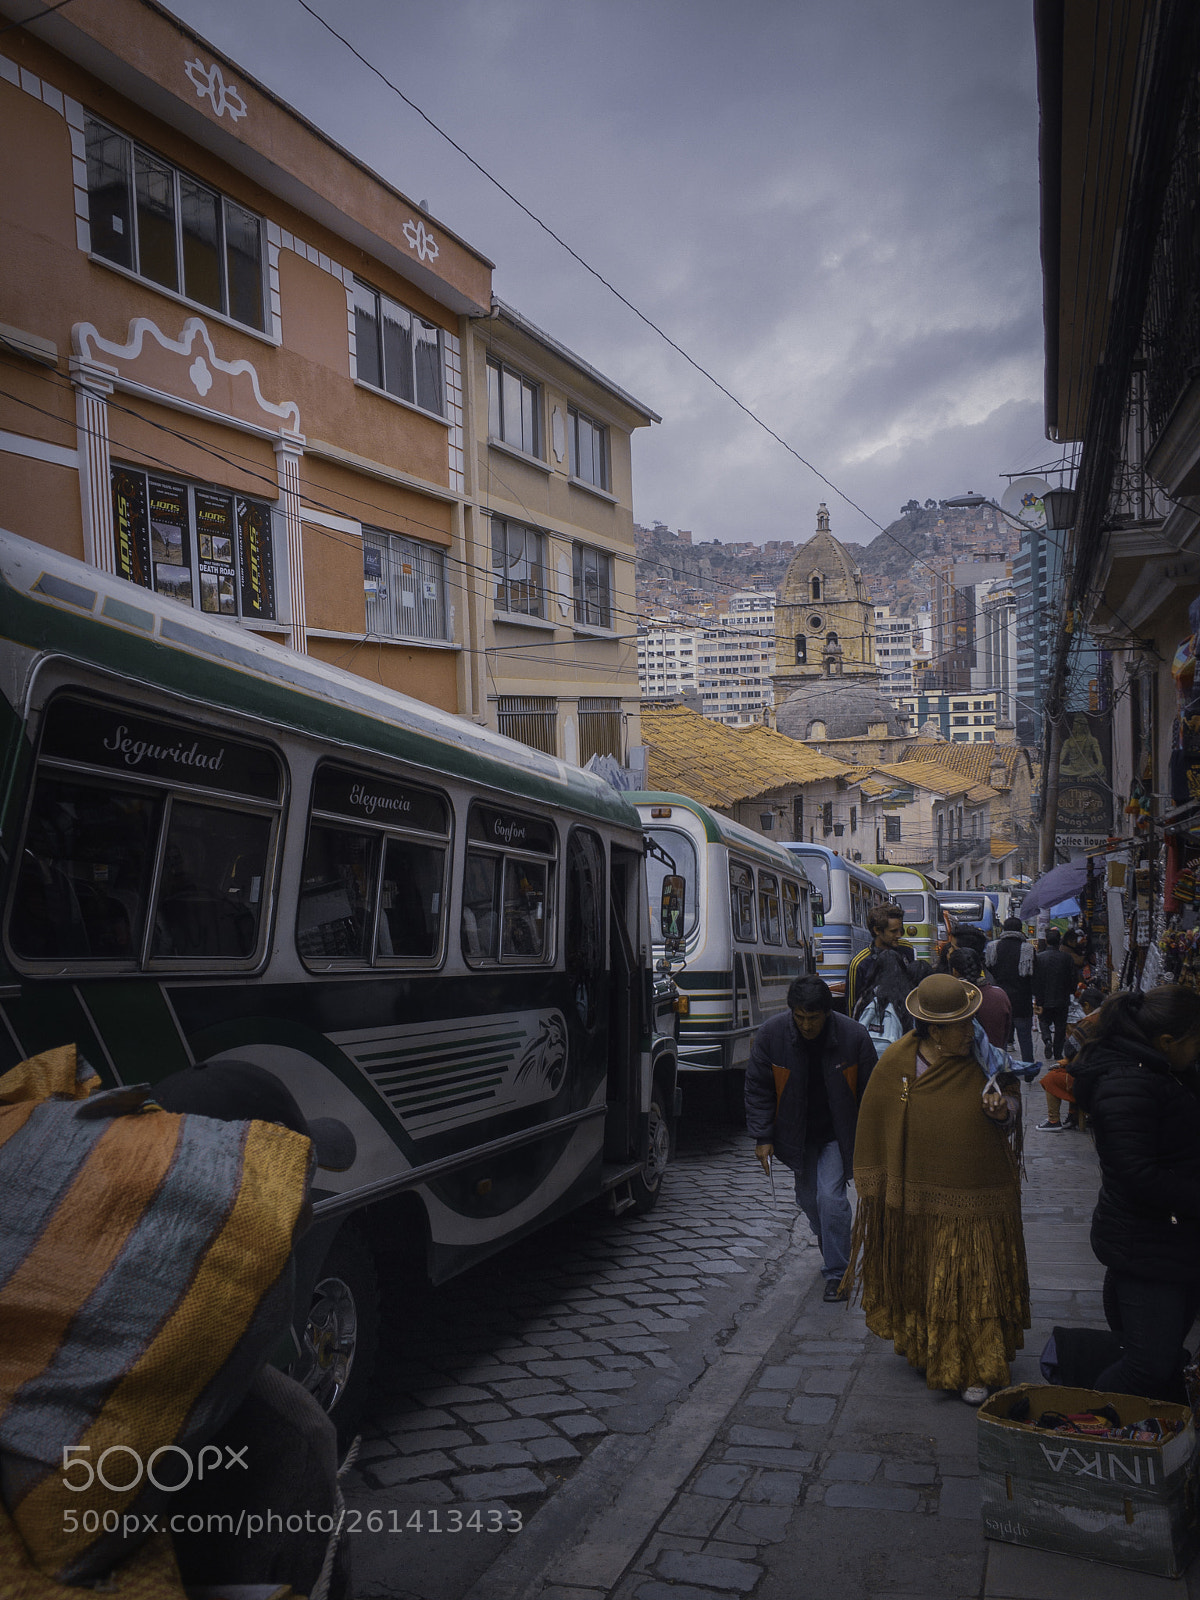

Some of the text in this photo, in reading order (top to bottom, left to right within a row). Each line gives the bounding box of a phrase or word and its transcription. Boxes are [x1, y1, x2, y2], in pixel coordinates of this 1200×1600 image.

[150, 499, 181, 512] LIONS
[199, 510, 227, 522] LIONS
[117, 493, 131, 583] IONS
[199, 564, 219, 574] DEATH
[219, 567, 235, 577] ROAD
[249, 524, 260, 611] LIONS
[103, 725, 225, 770] Seguridad
[350, 784, 411, 814] Elegancia
[1057, 798, 1074, 808] Old
[494, 818, 526, 842] Confort
[1055, 836, 1107, 846] Coffee House
[1038, 1443, 1156, 1485] INKA
[985, 1518, 1031, 1538] apples
